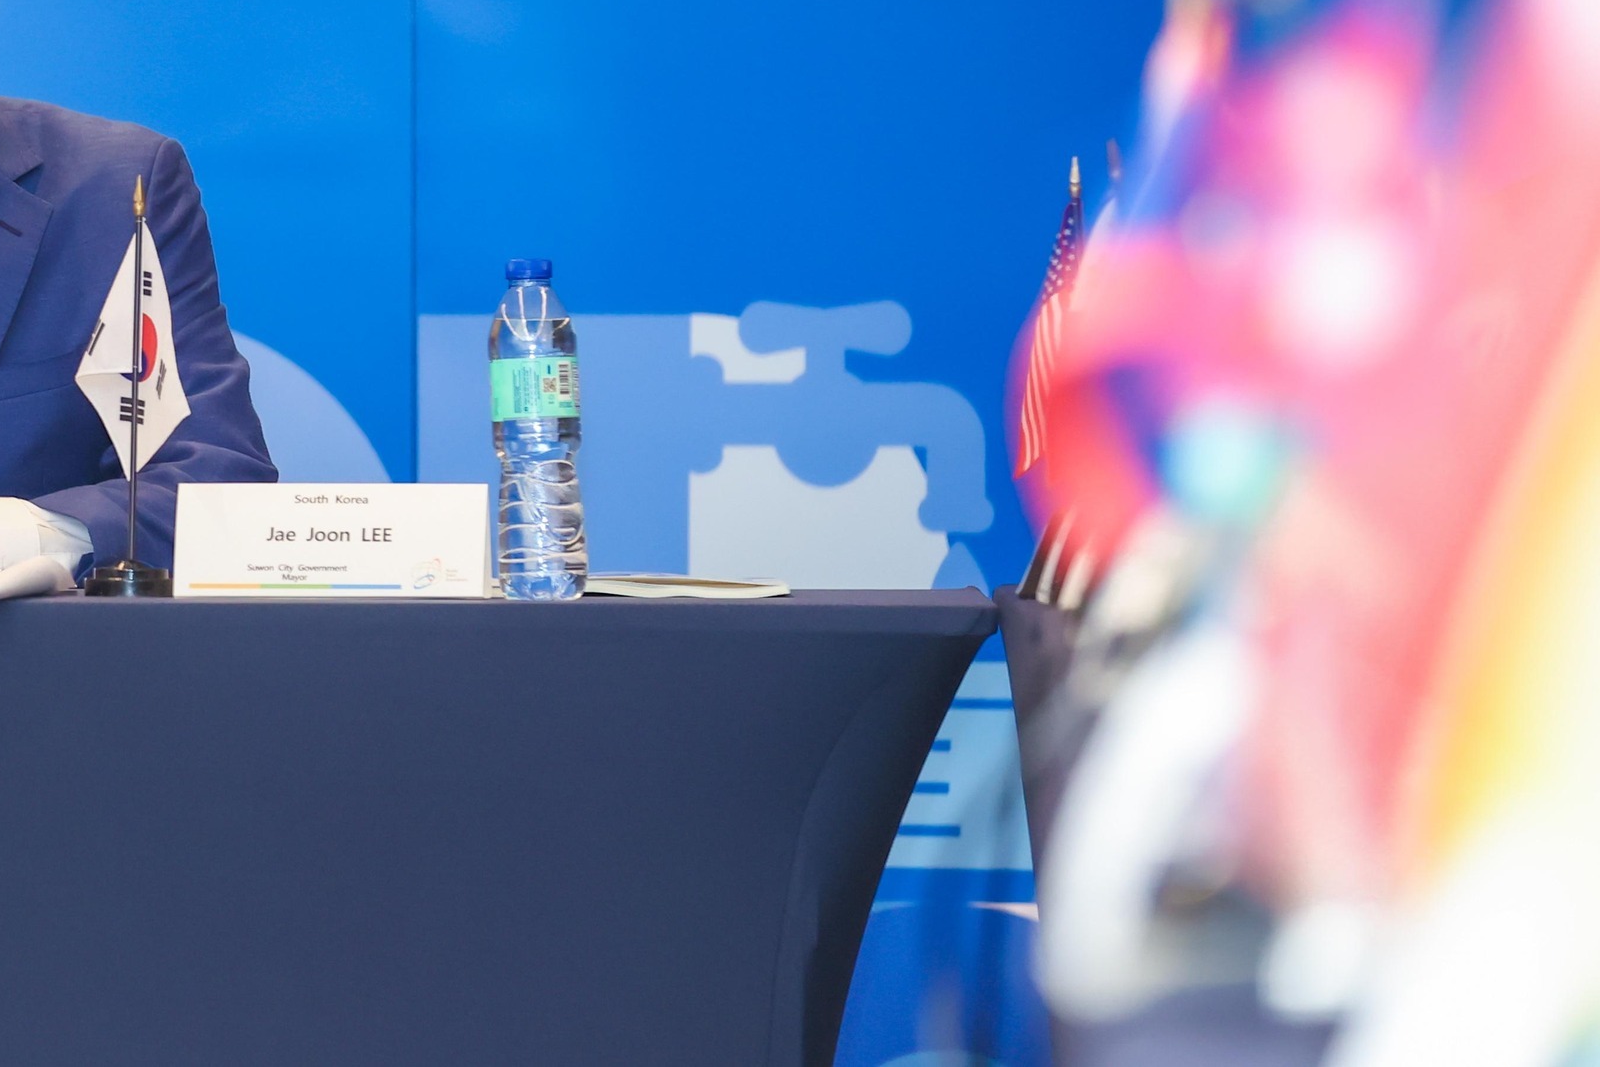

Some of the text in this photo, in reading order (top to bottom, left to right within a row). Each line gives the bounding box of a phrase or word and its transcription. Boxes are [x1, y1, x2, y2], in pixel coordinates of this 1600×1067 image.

[294, 494, 369, 504] South Korea
[266, 527, 393, 542] Jae Joon LEE
[247, 564, 347, 573] Suwon City Government
[282, 574, 307, 582] Mayor
